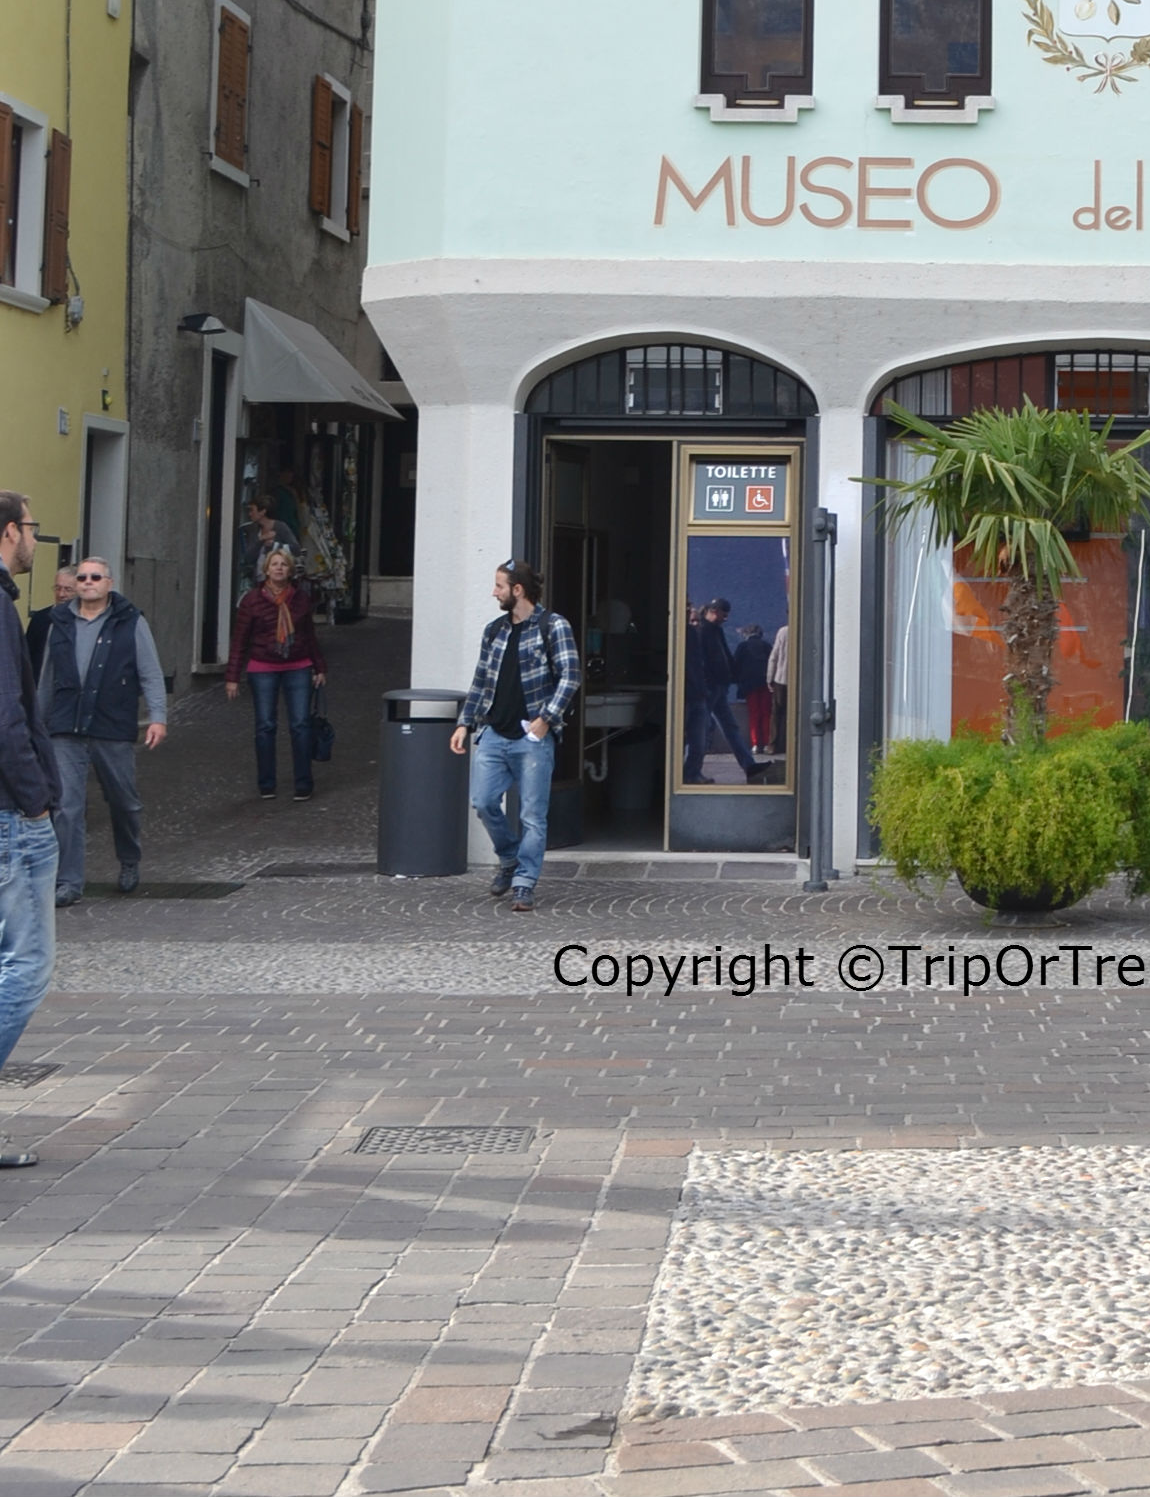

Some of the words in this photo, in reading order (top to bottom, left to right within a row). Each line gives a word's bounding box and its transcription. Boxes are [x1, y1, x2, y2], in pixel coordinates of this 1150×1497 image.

[653, 154, 1001, 231] MUSEO
[1072, 159, 1144, 232] del
[706, 466, 777, 479] TOILETTE
